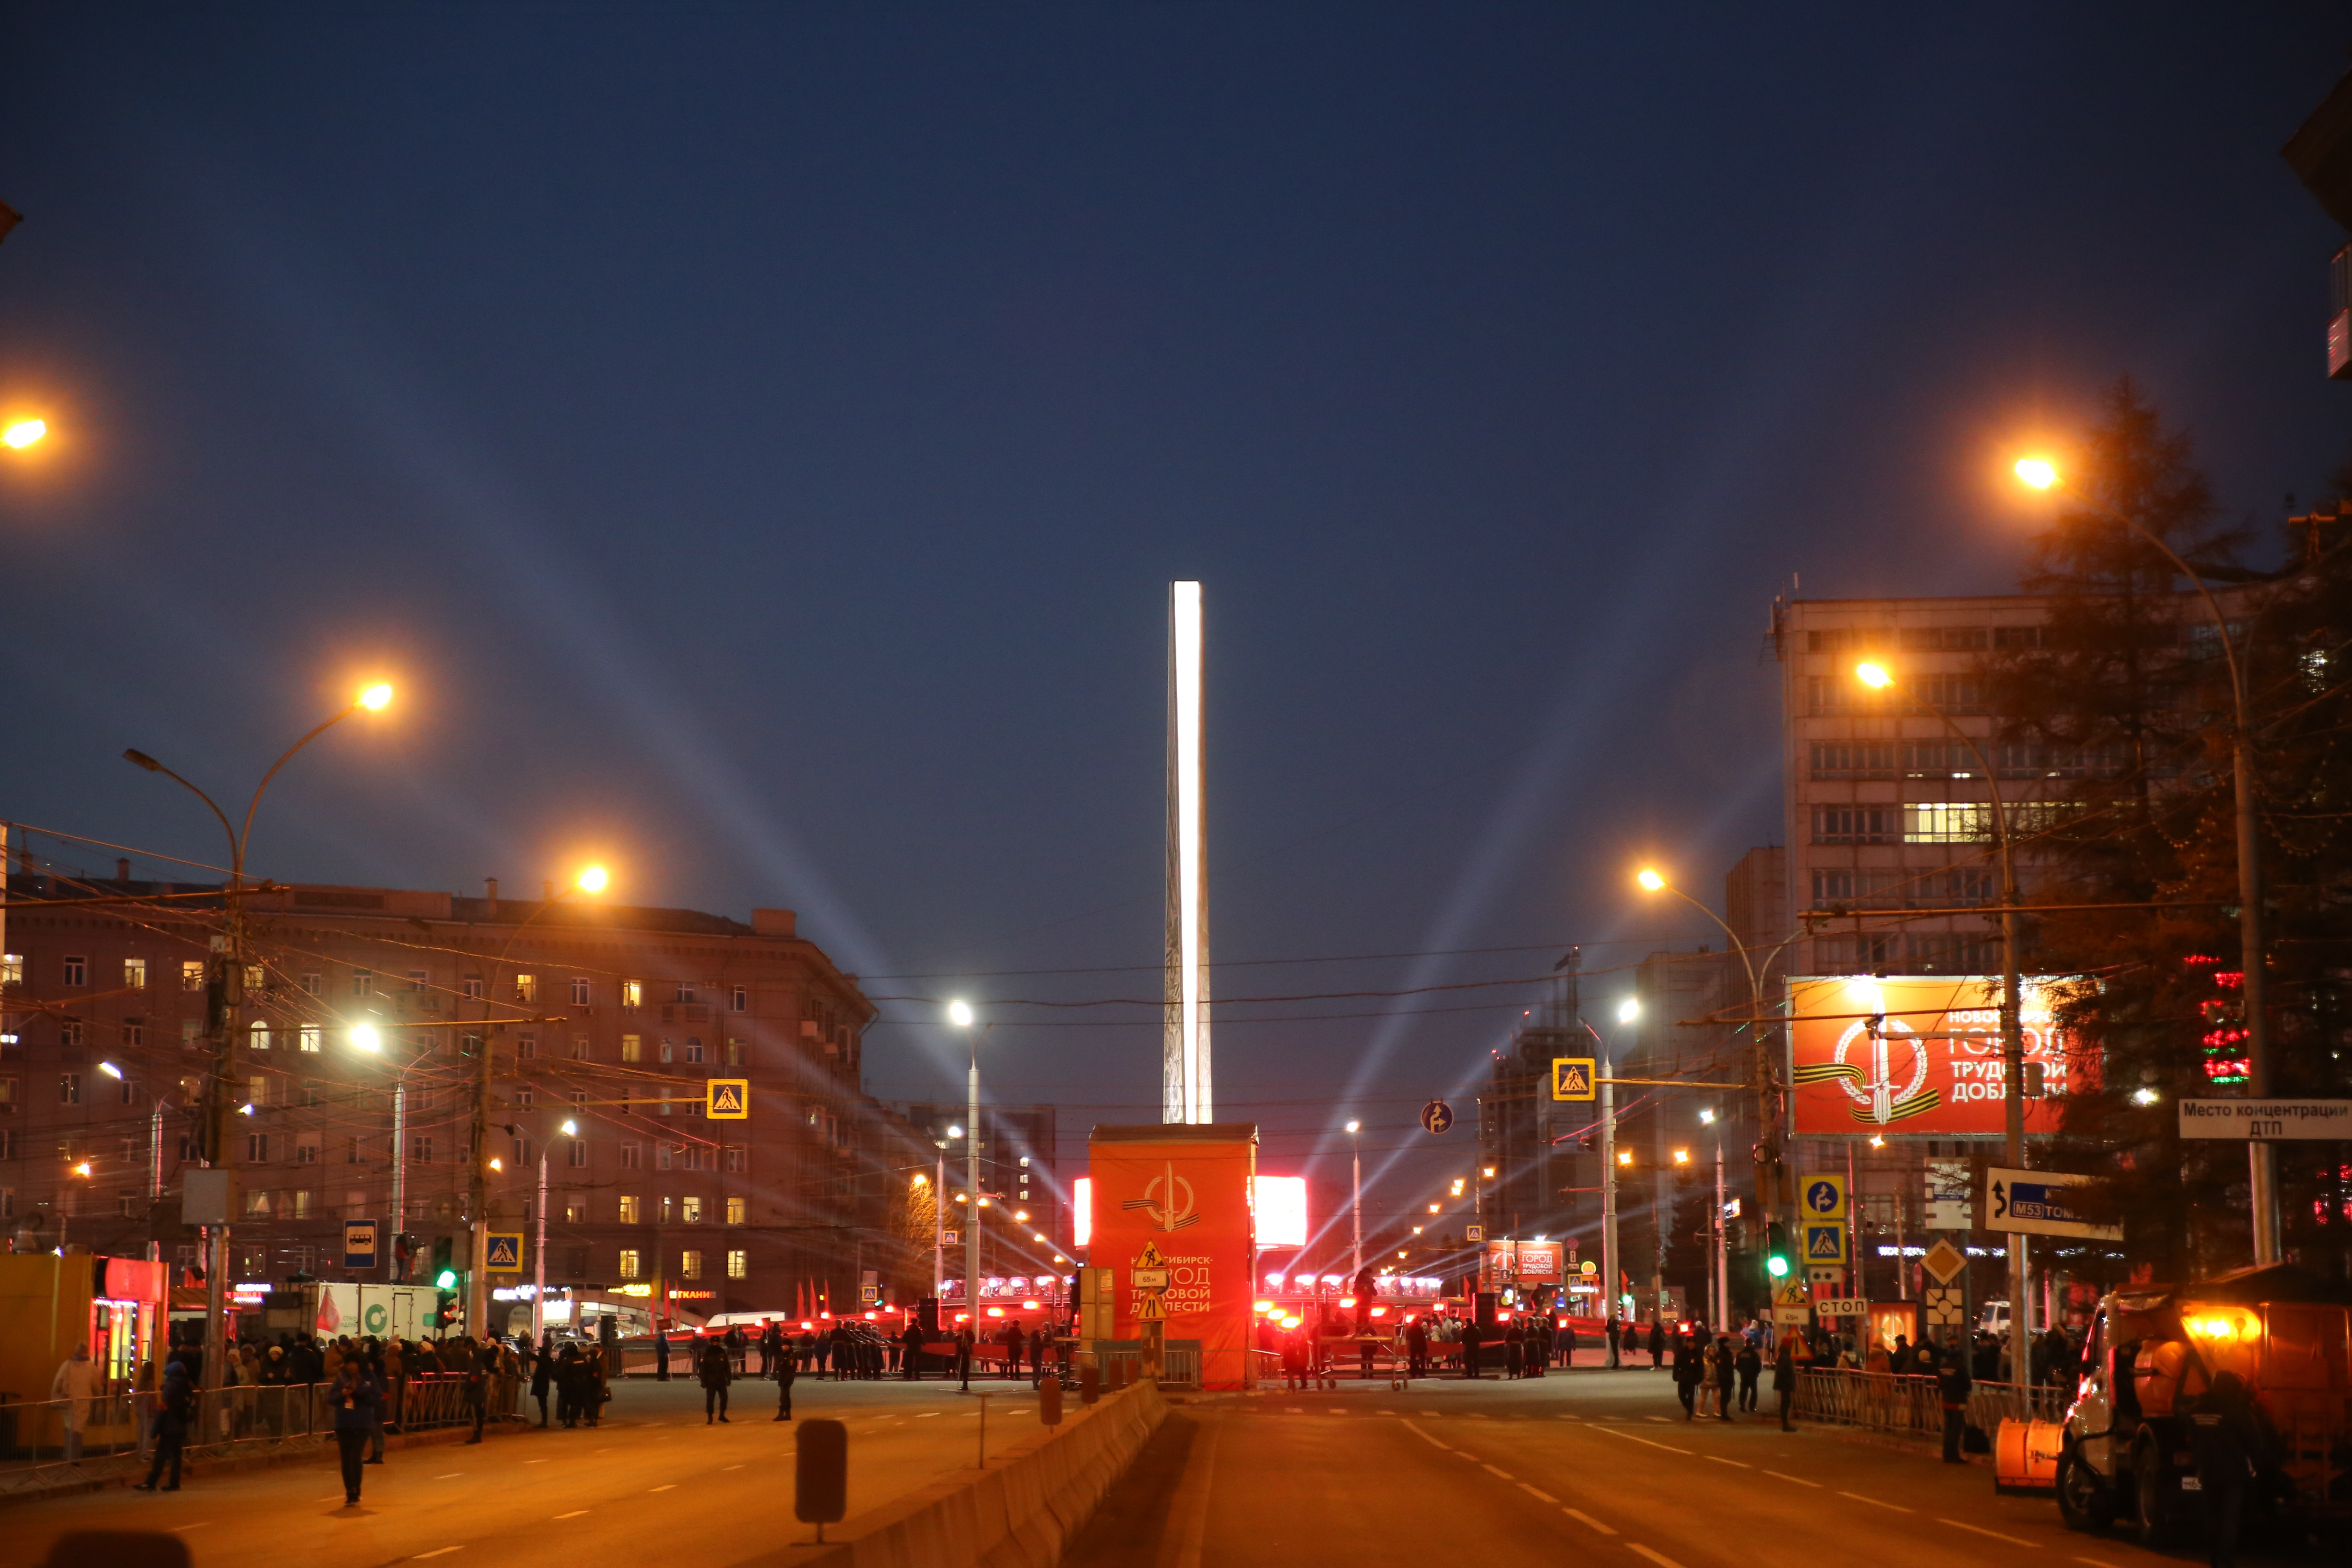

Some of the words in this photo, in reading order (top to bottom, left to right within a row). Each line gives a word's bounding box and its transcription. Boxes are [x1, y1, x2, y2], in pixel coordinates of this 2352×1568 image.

[2184, 1103, 2231, 1117] Место
[2237, 1106, 2348, 1120] концентрации
[2250, 1121, 2282, 1137] ДТП
[2016, 1204, 2041, 1216] М53
[1522, 1255, 1553, 1263] ГОРОД
[1819, 1301, 1864, 1313] СТОП
